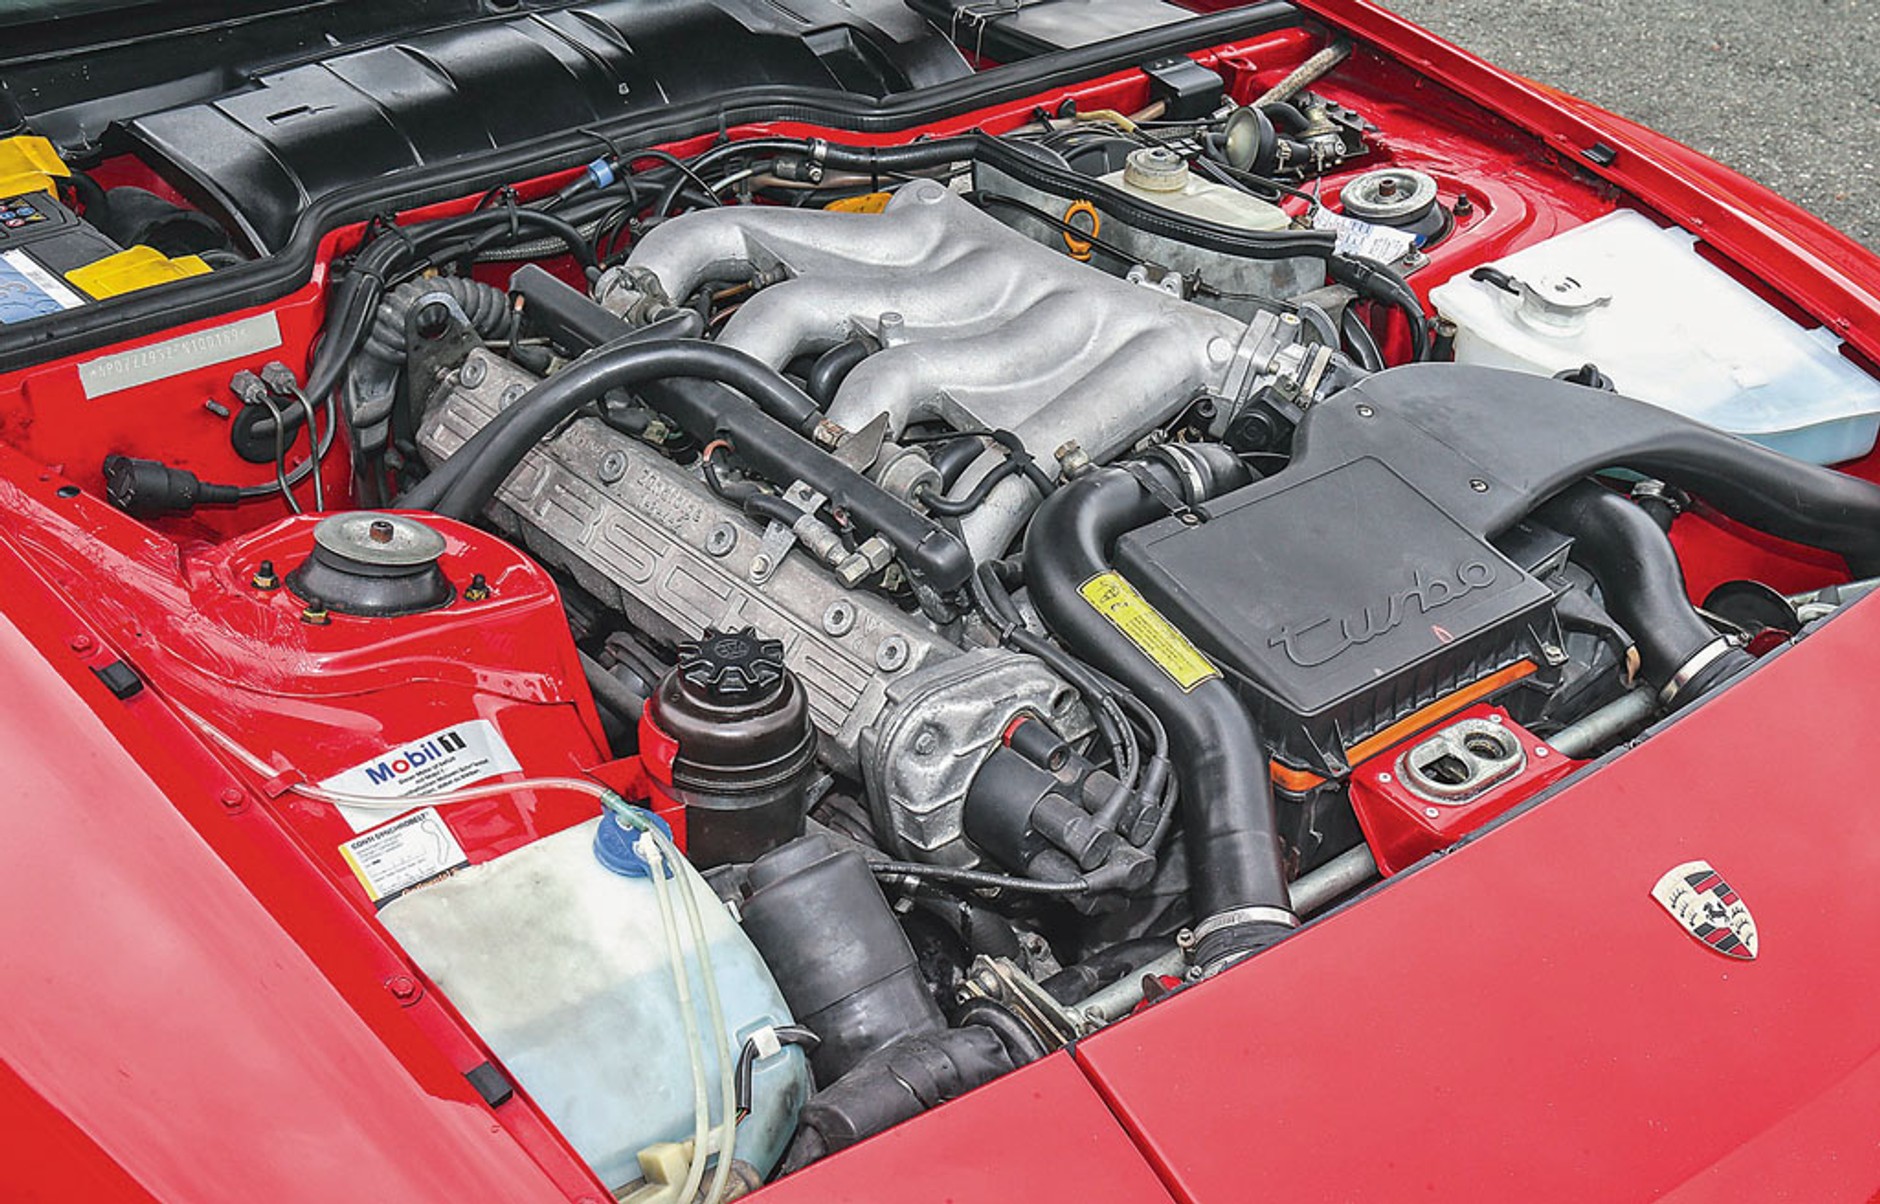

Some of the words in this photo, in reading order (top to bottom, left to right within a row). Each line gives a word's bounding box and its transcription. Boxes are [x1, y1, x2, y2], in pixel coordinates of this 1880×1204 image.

[1266, 560, 1496, 668] turbo
[365, 741, 442, 785] Mobil
[437, 731, 468, 754] 1
